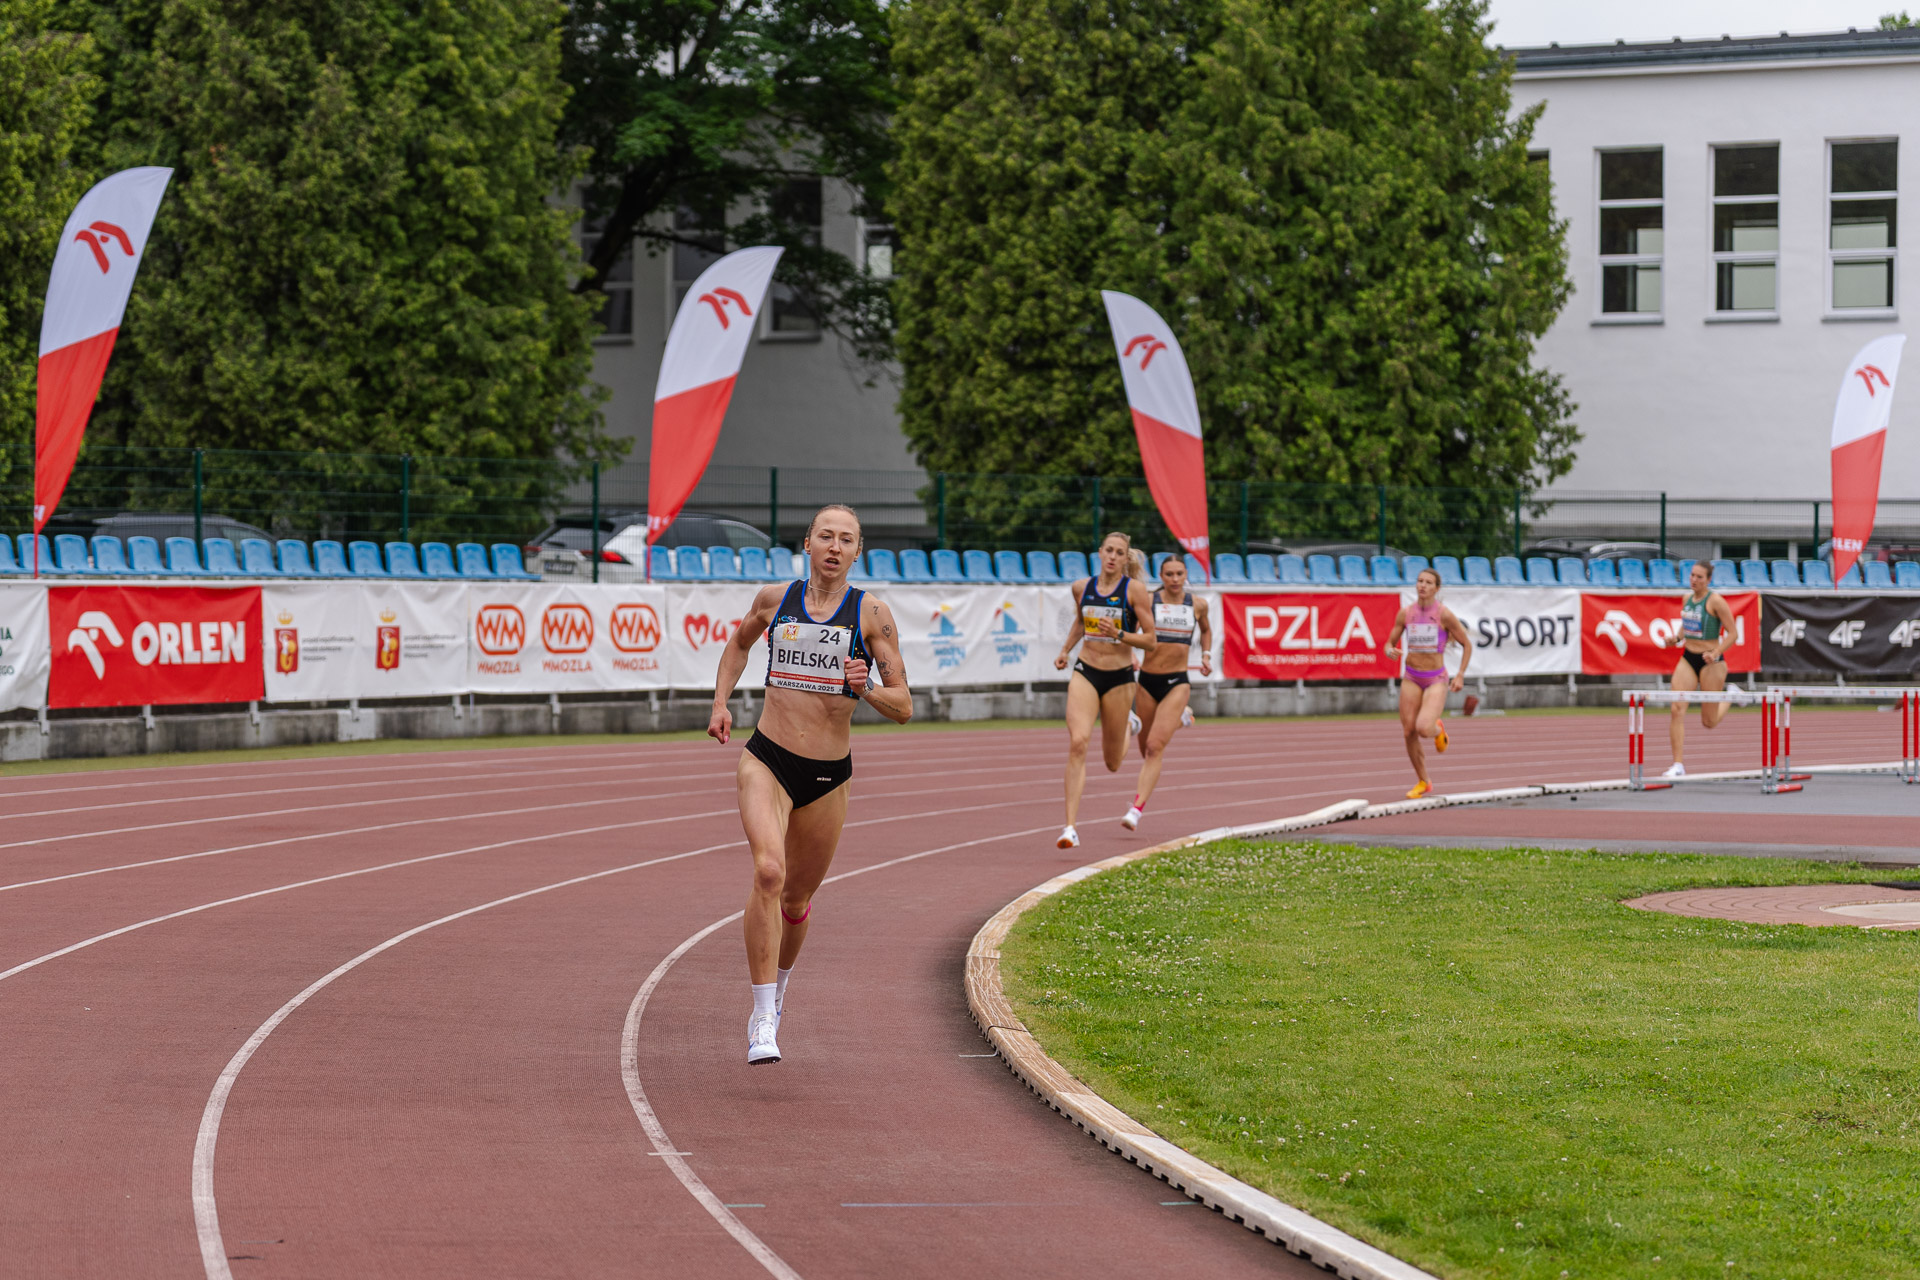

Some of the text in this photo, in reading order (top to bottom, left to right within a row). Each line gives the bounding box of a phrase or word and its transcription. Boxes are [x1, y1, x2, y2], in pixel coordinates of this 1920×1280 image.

[1105, 608, 1117, 618] 27
[818, 628, 841, 646] 24
[1245, 605, 1376, 649] PZLA
[1476, 615, 1574, 649] SPORT
[1770, 618, 1807, 647] 4F
[1828, 620, 1866, 649] 4F
[132, 620, 246, 666] ORLEN
[477, 659, 521, 675] WMOZLA
[542, 658, 593, 673] WMOZLA
[612, 657, 659, 672] WMOZLA
[777, 648, 840, 671] BIELSKA
[777, 680, 817, 691] WARSZAWA
